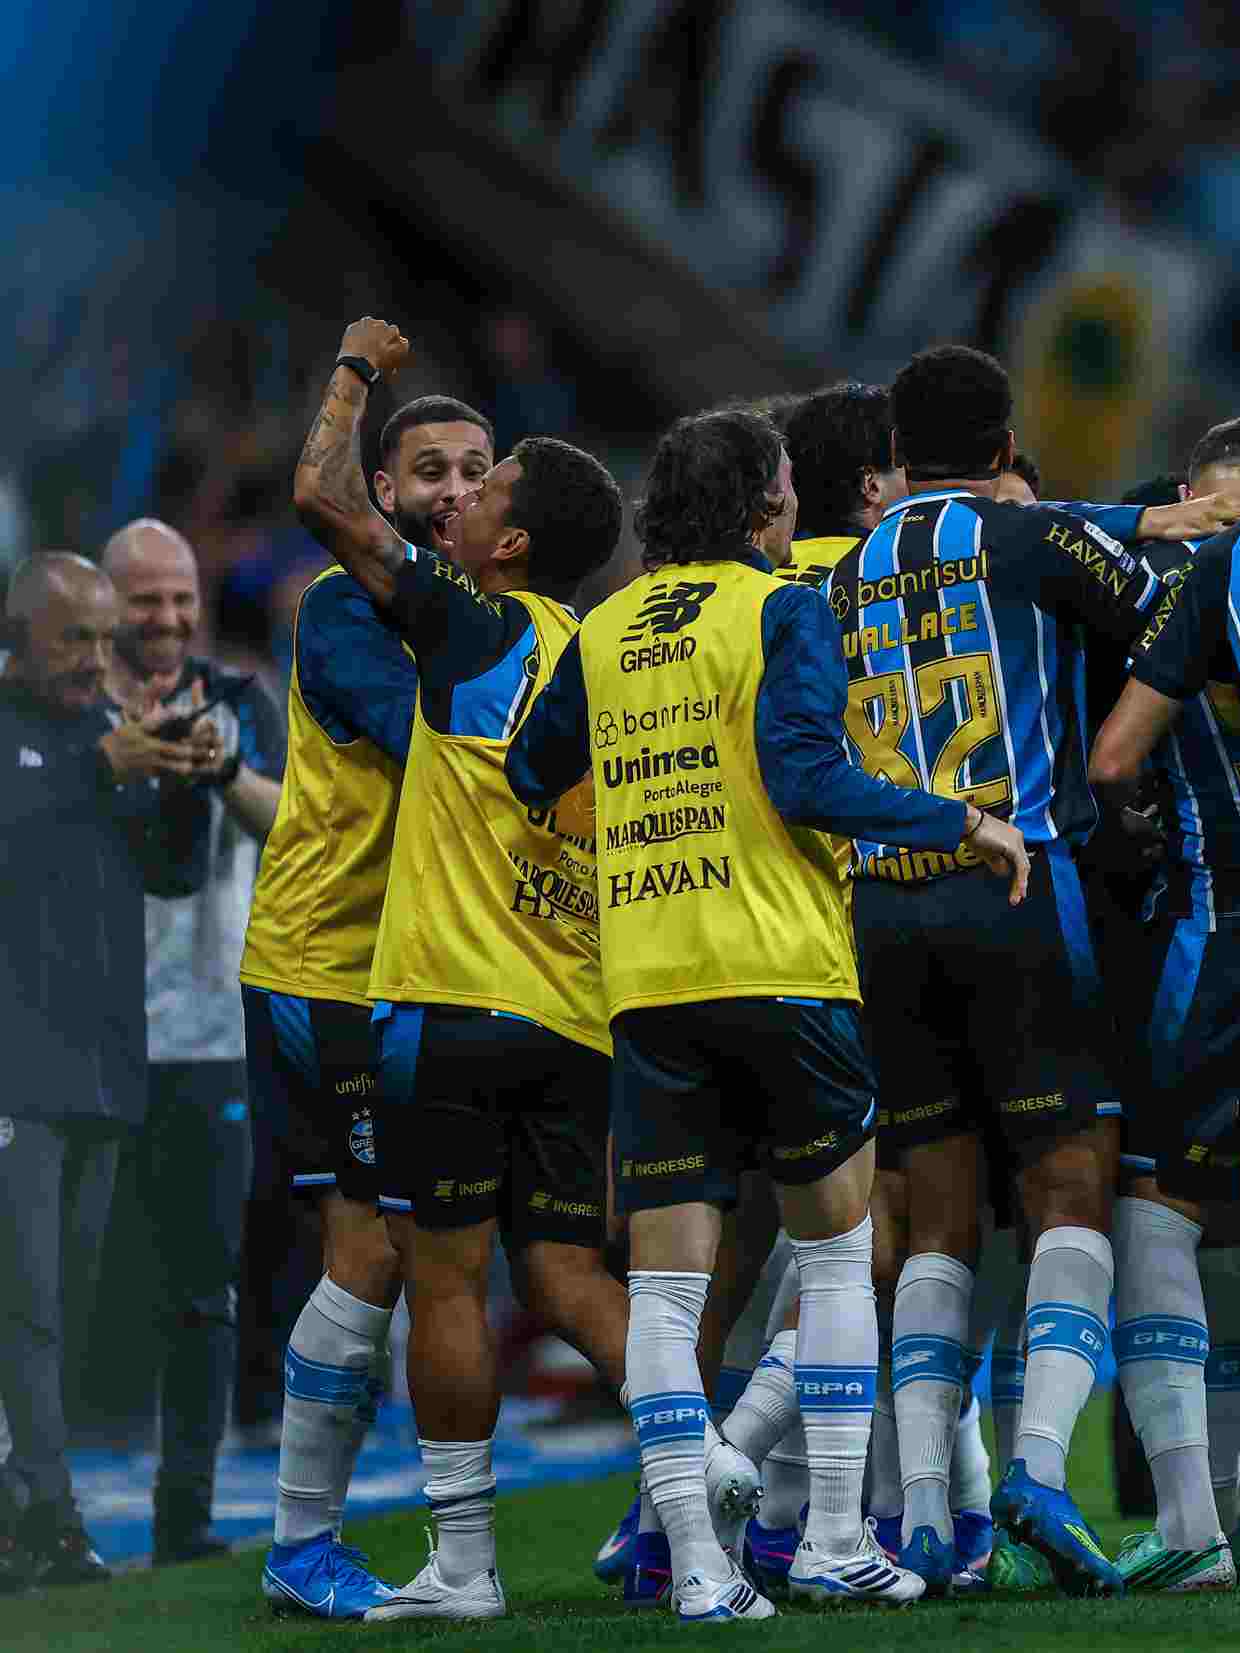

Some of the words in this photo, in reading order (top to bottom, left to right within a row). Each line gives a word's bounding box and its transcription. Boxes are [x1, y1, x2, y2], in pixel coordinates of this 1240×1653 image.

[856, 549, 991, 608] banrisul
[1044, 521, 1130, 597] HAVAN
[842, 652, 1013, 809] 82
[607, 855, 732, 909] HAVAN
[632, 1154, 706, 1177] INGRESSE
[552, 1198, 601, 1218] INGRES
[1132, 1330, 1210, 1354] GFBP
